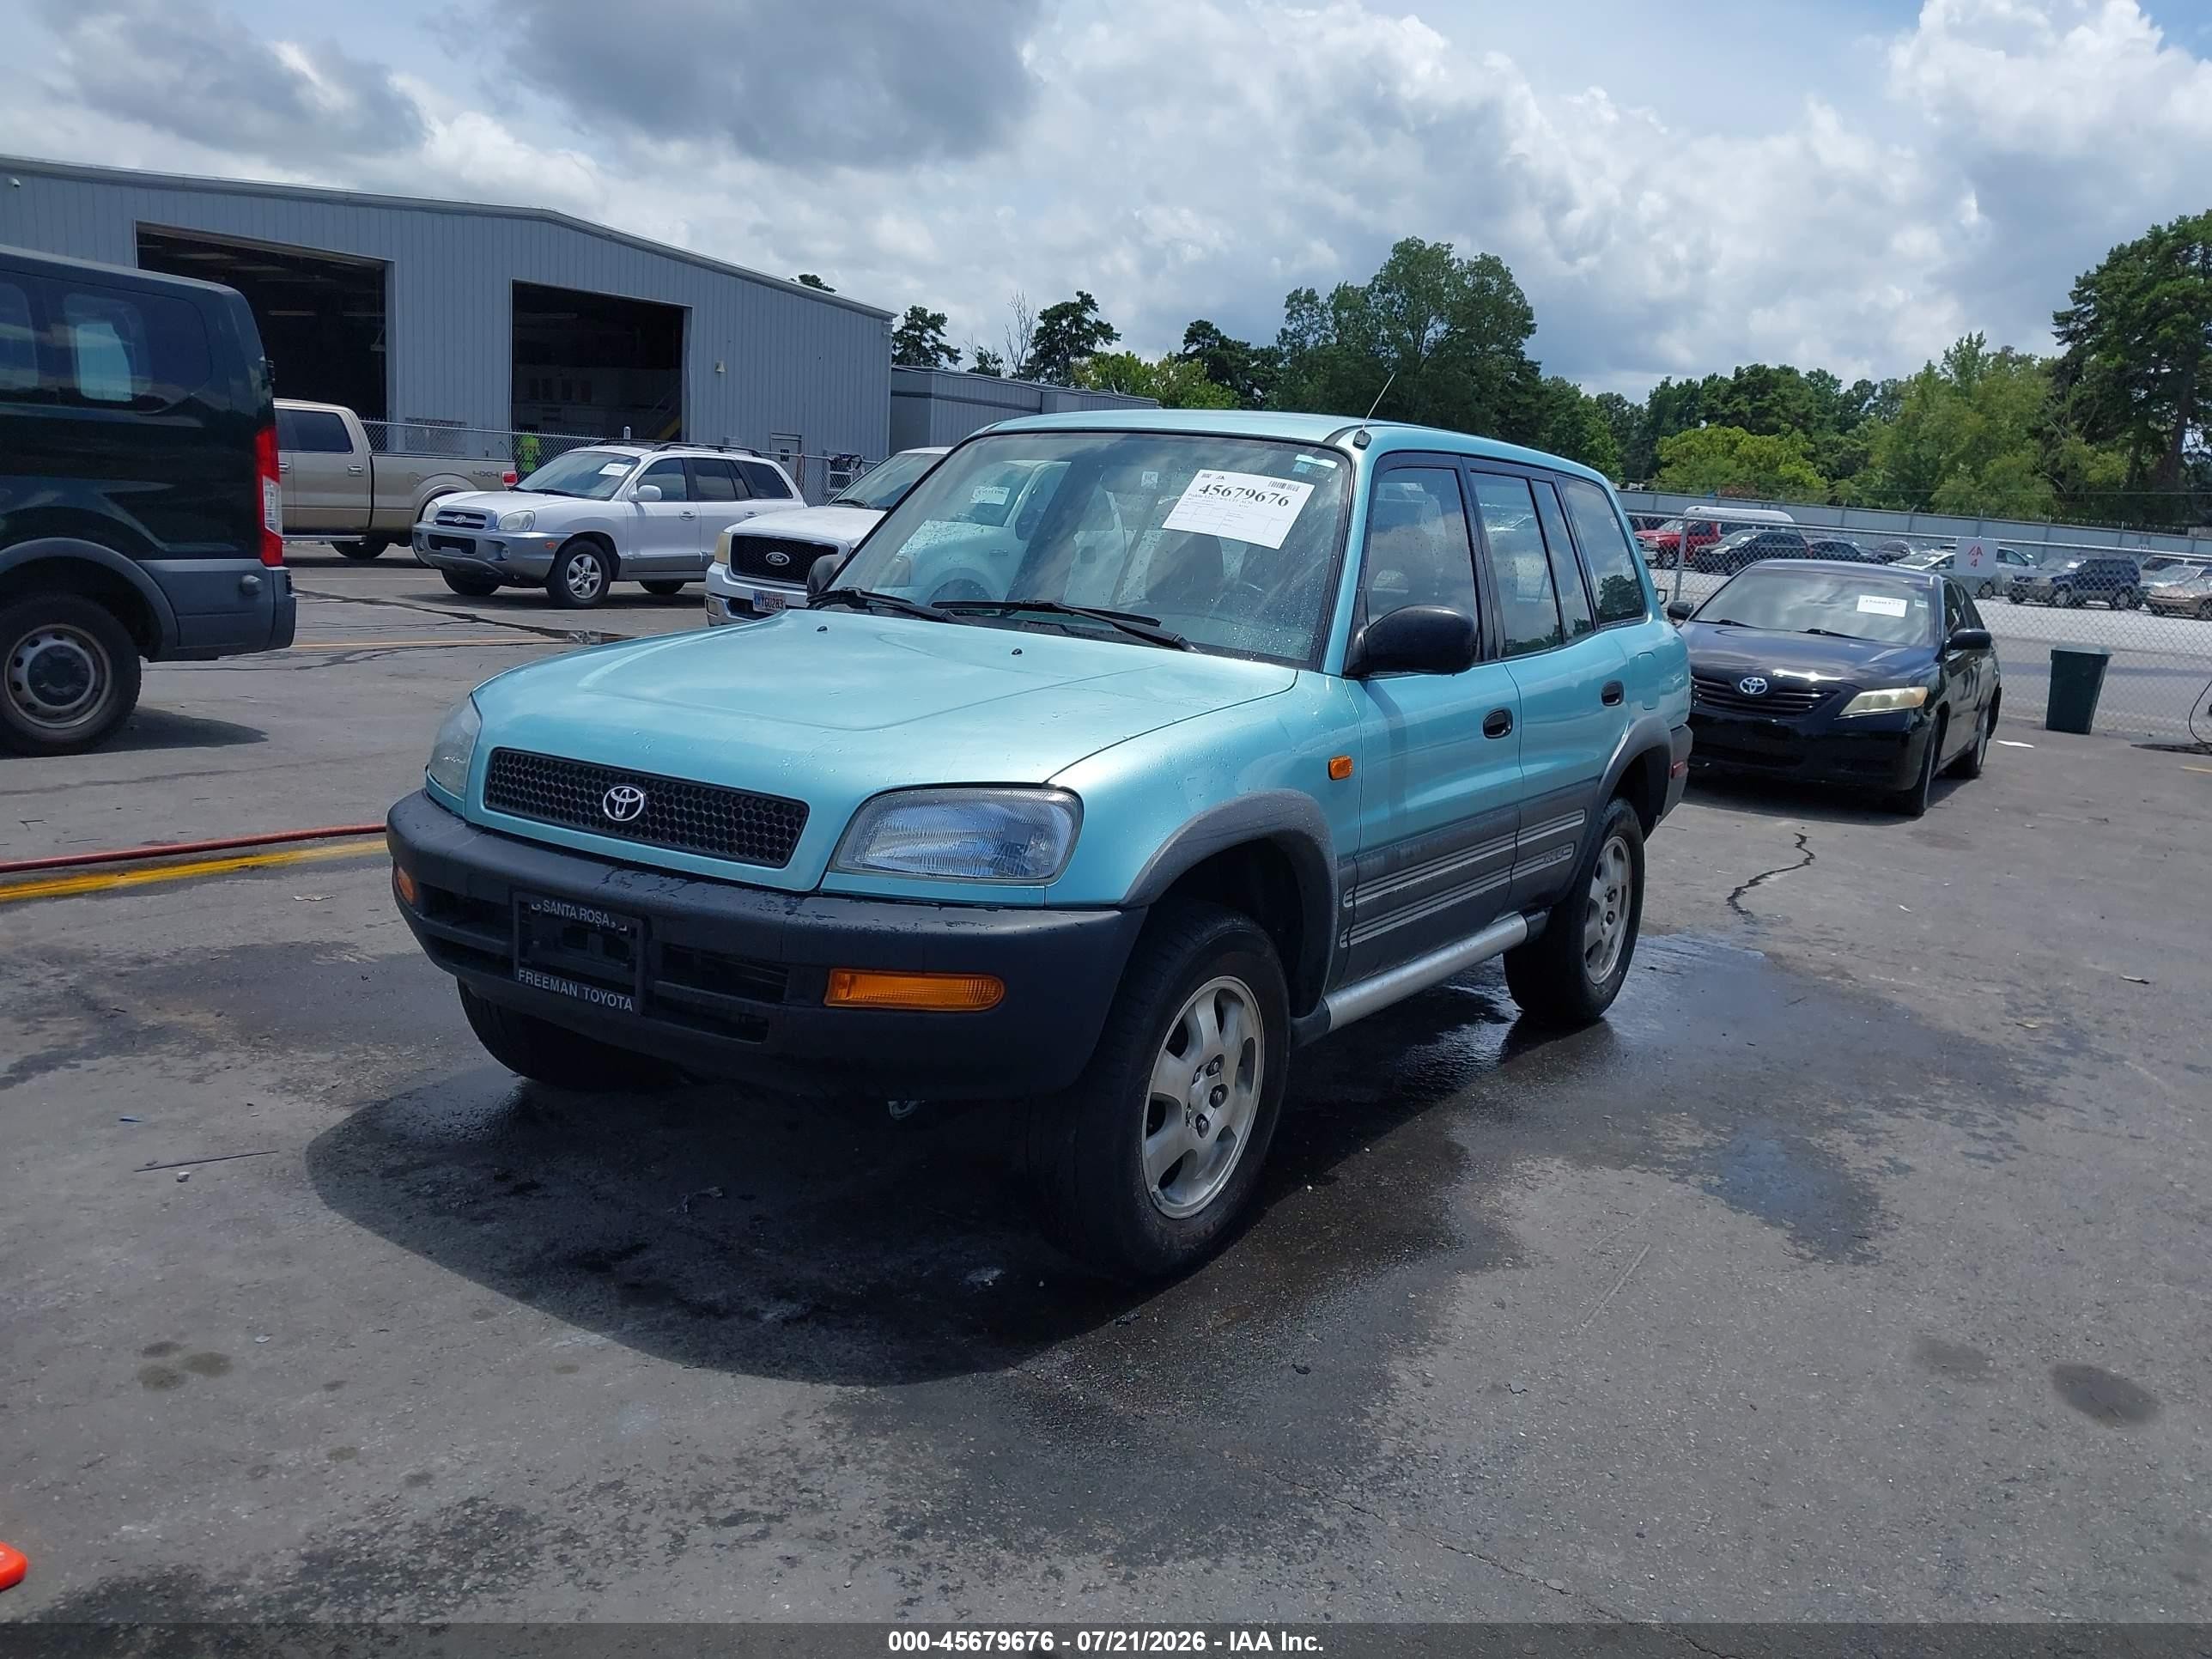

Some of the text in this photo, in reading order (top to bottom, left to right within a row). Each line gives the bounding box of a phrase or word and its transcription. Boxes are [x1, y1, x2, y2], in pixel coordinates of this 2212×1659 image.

[1199, 483, 1292, 507] 45679676
[543, 899, 610, 927] SANTA ROSA
[518, 968, 634, 1012] FREEMAN TOYOTA
